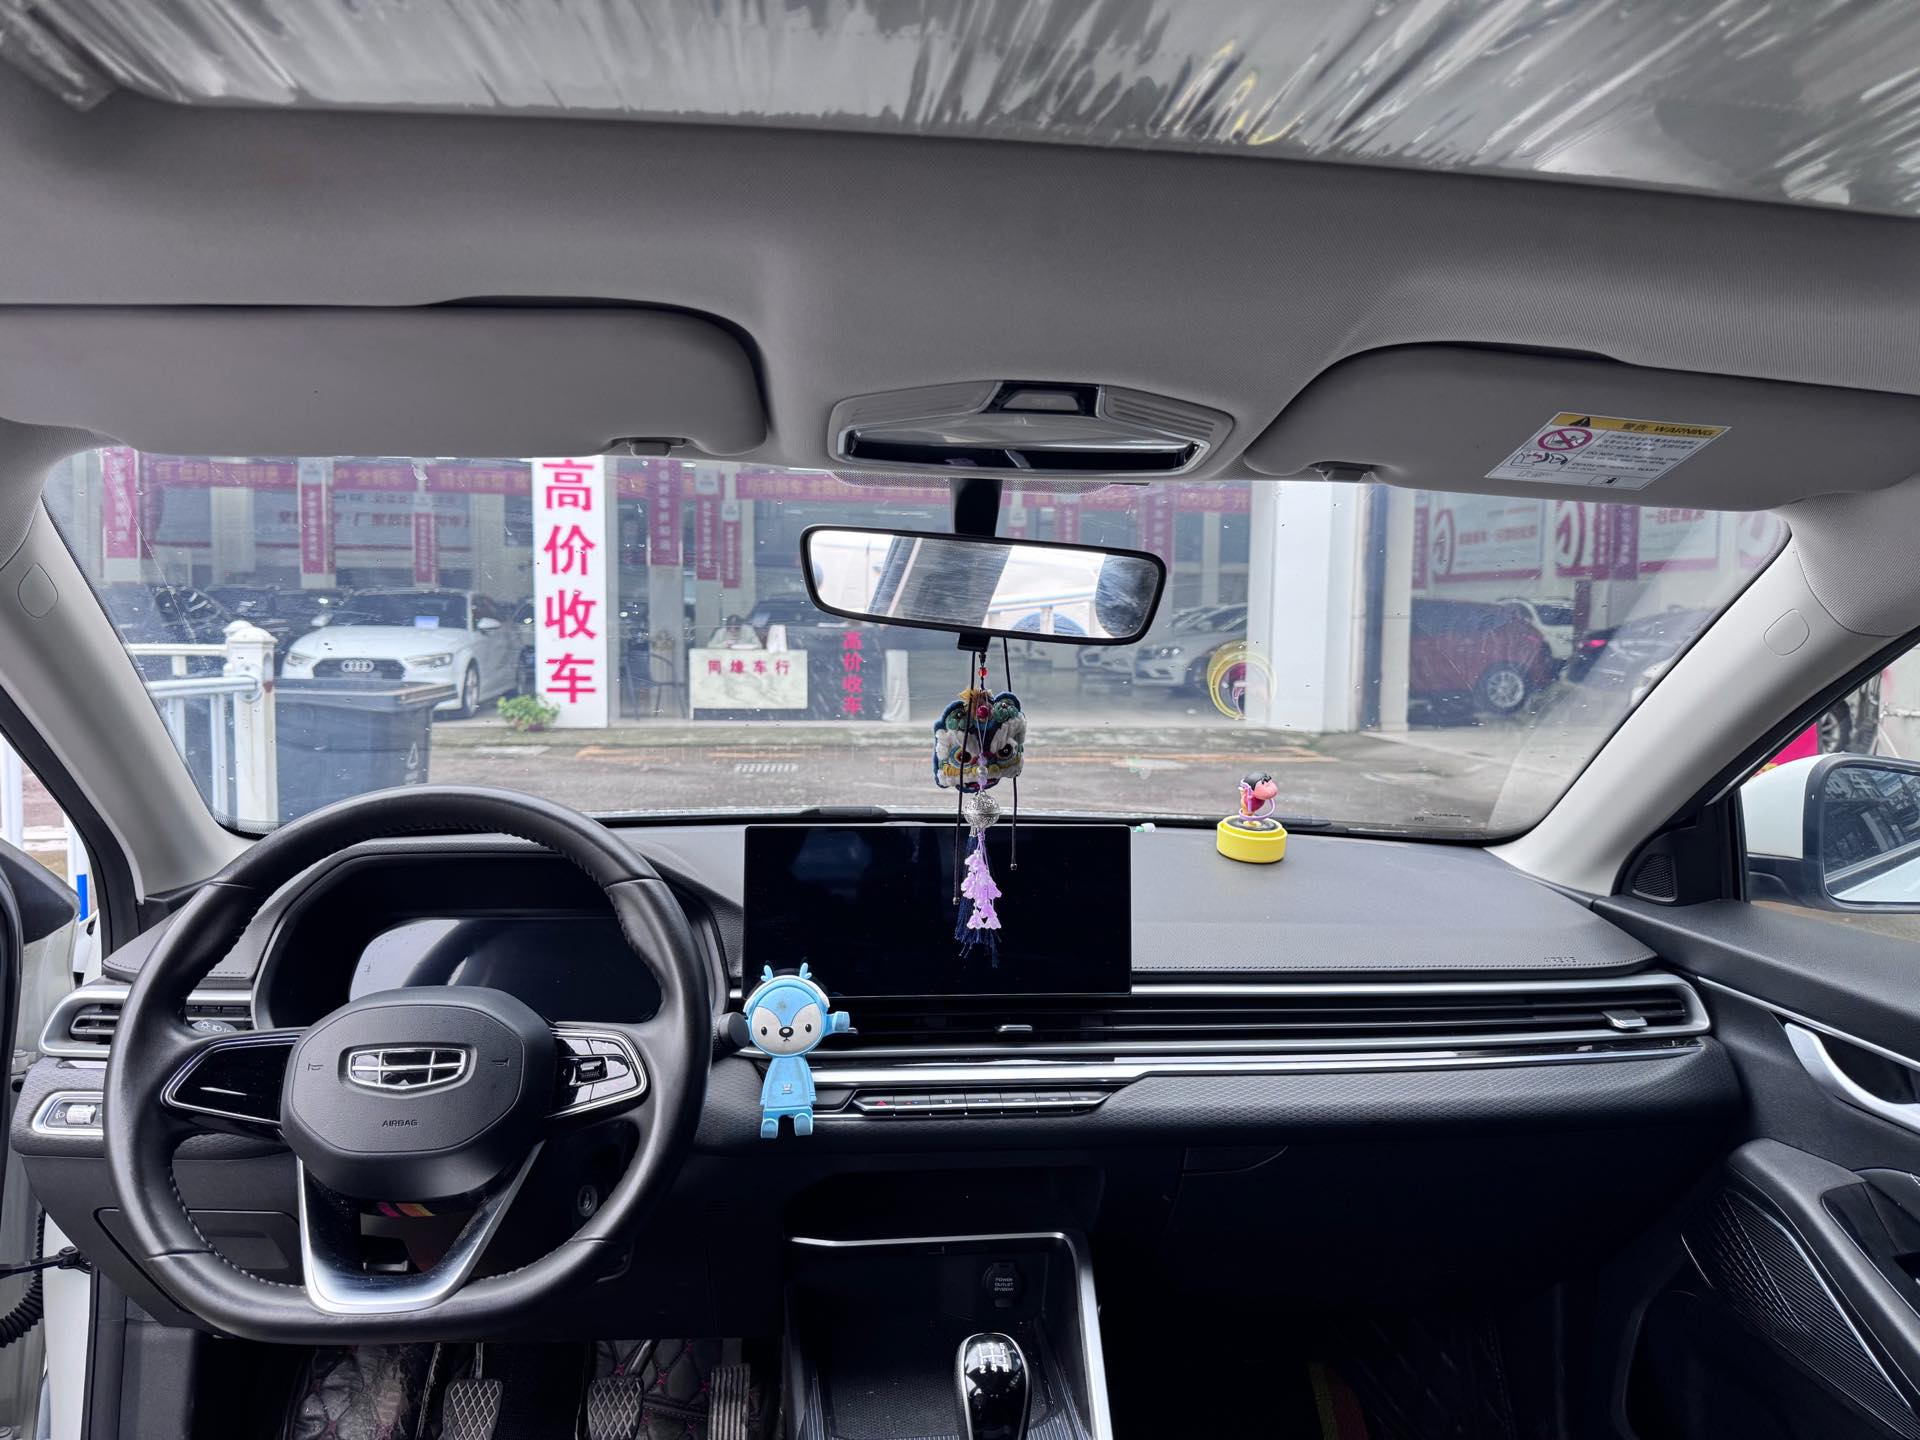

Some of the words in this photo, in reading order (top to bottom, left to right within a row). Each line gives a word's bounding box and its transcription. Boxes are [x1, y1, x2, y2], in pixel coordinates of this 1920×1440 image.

[1654, 425, 1716, 436] WARNING
[542, 459, 597, 704] 高价收车
[842, 631, 865, 715] 高价收车
[382, 1119, 419, 1127] AIRBAG
[979, 1365, 987, 1374] 2
